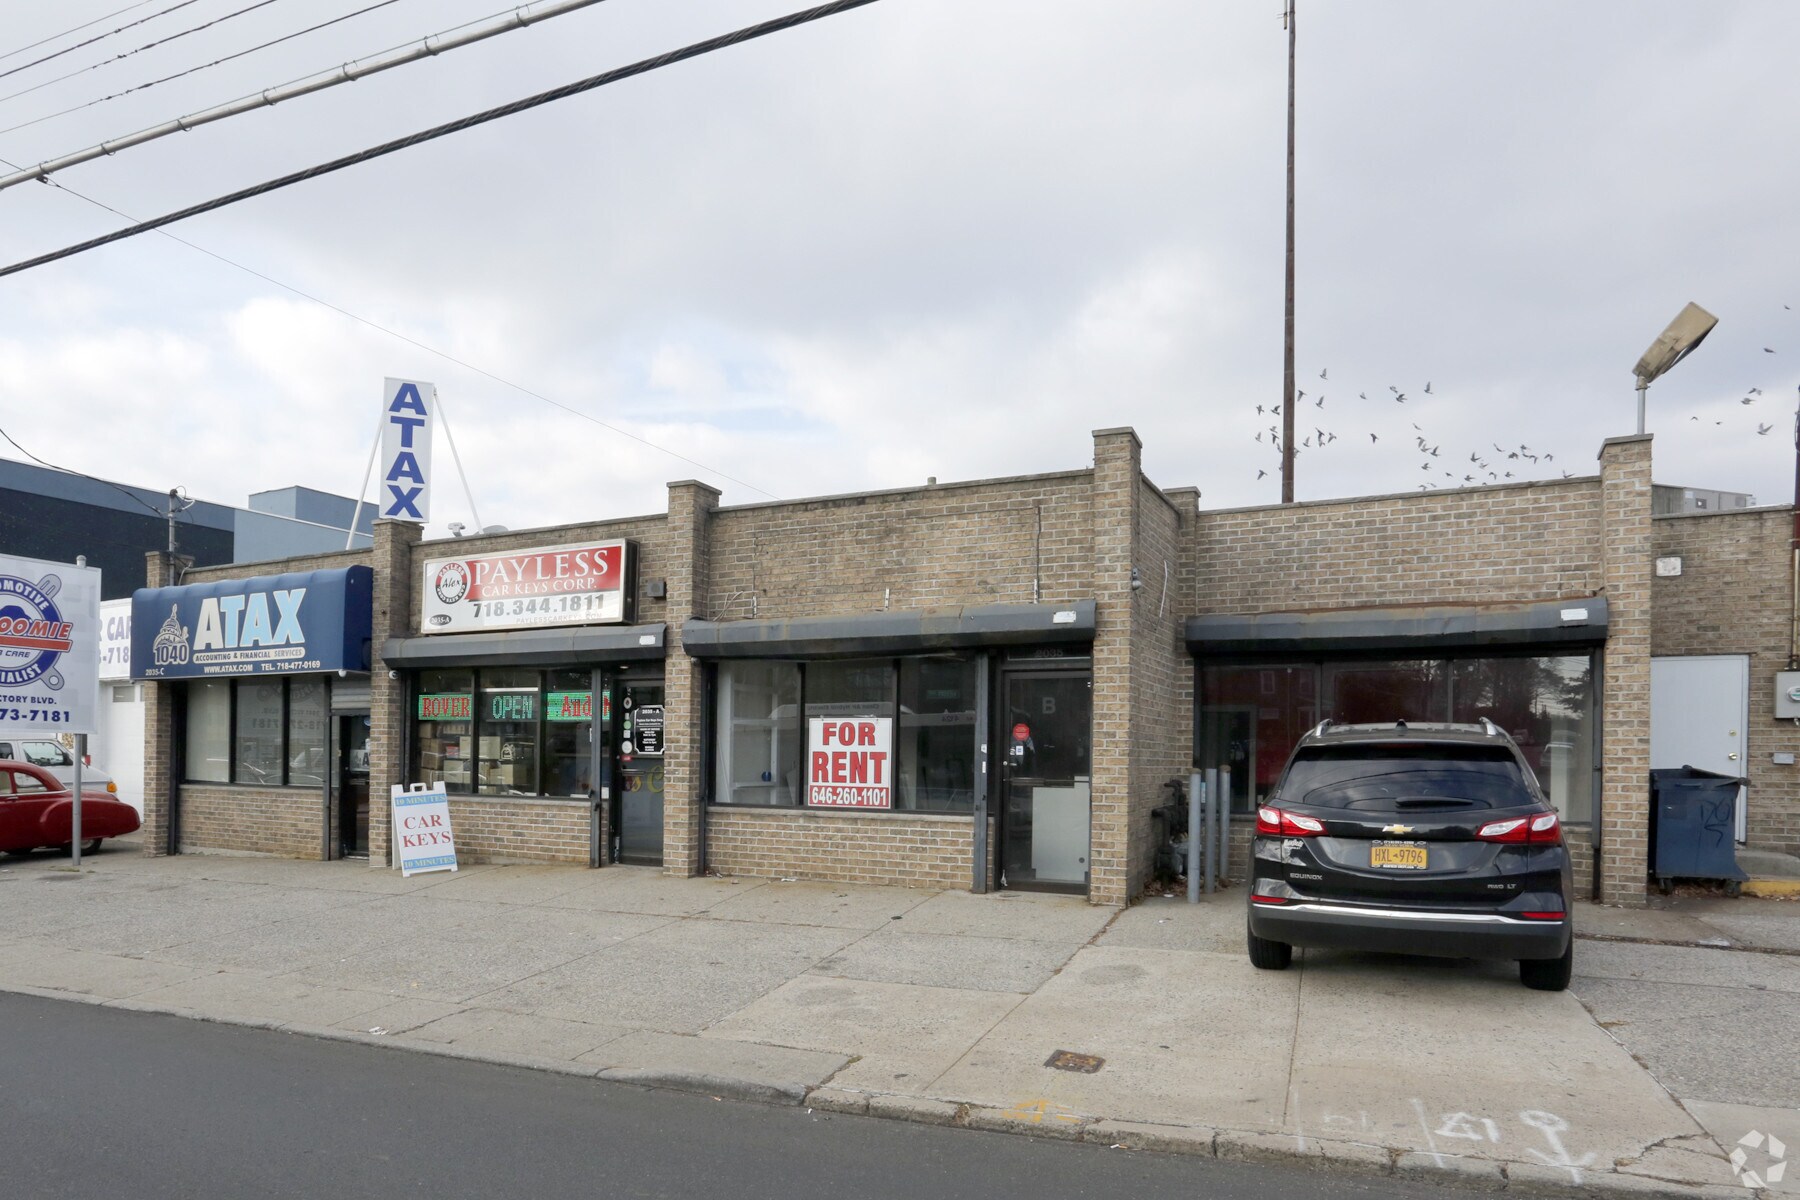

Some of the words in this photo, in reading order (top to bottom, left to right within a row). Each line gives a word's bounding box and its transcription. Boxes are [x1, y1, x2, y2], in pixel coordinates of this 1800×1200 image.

[385, 382, 428, 519] ATAX
[473, 549, 609, 586] PAYLESS
[0, 579, 50, 611] MOTIVE
[481, 585, 510, 598] CAR
[514, 580, 548, 595] KEYS
[552, 576, 598, 592] CORP.
[473, 593, 605, 618] 718.344.1811
[193, 588, 307, 650] ATAX
[155, 643, 188, 665] 1040
[195, 653, 231, 662] ACCOUNTING
[239, 651, 271, 660] FINANCIAL
[274, 649, 302, 657] SERVICES
[204, 664, 253, 673] WWW.ATAX.COM
[261, 663, 275, 671] TEL.
[277, 660, 321, 670] 718-477-0169
[0, 695, 27, 703] TORY
[31, 697, 57, 705] BLVD.
[422, 696, 470, 718] ROVER
[492, 695, 533, 719] OPEN
[1042, 697, 1056, 714] B
[822, 722, 876, 747] FOR
[812, 751, 887, 784] RENT
[407, 794, 446, 805] MINUTES
[812, 787, 887, 806] 646-260-1101
[404, 814, 443, 830] CAR
[403, 831, 451, 848] KEYS
[416, 857, 455, 868] MINUTES
[1374, 848, 1392, 862] HXL
[1400, 849, 1423, 864] 9796
[1289, 872, 1323, 881] EQUINOX
